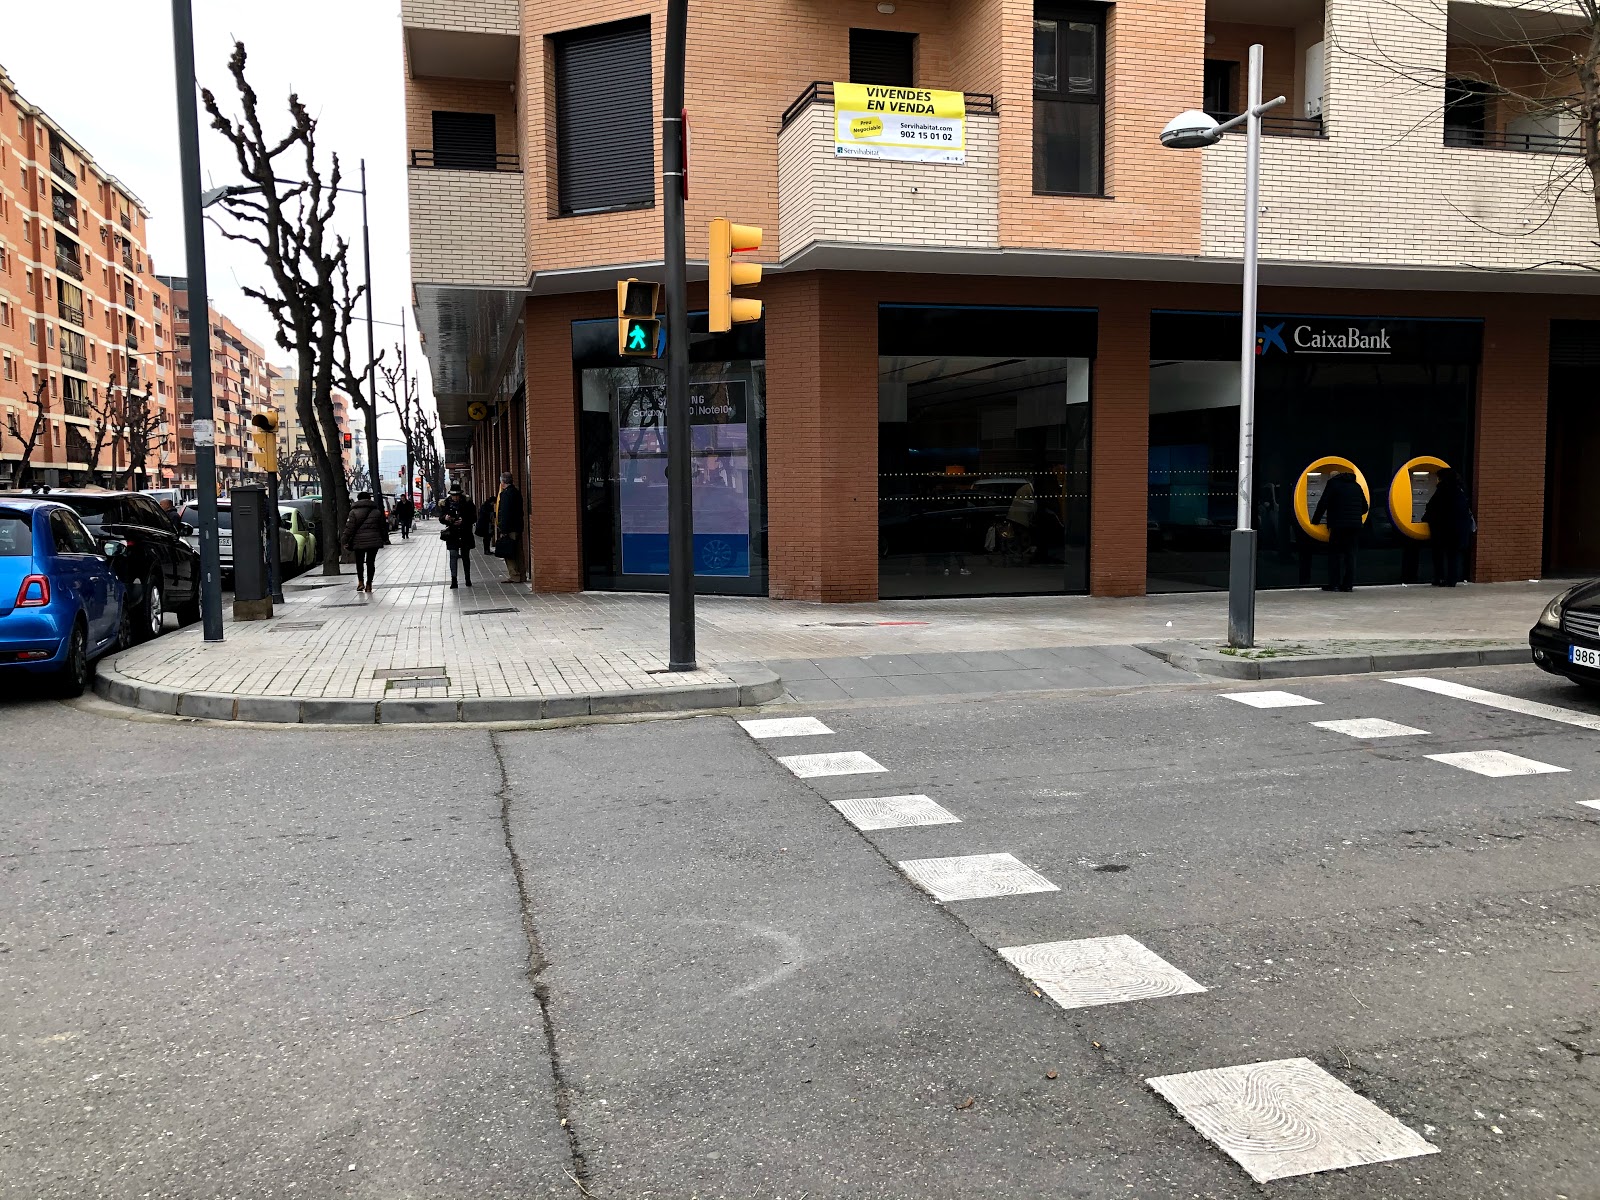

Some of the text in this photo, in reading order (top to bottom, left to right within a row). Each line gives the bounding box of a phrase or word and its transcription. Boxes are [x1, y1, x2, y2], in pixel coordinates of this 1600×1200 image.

[866, 87, 932, 102] VIVENDES
[867, 99, 935, 115] EN VENDA
[853, 125, 881, 133] Negociable
[900, 122, 953, 132] Servihabitat.com
[900, 130, 953, 141] 902 15 01 02
[843, 147, 880, 156] Servihabitat
[1293, 325, 1392, 349] CaixaBank
[658, 395, 705, 406] SANG
[632, 408, 665, 418] Galaxy
[698, 405, 732, 415] Note10+
